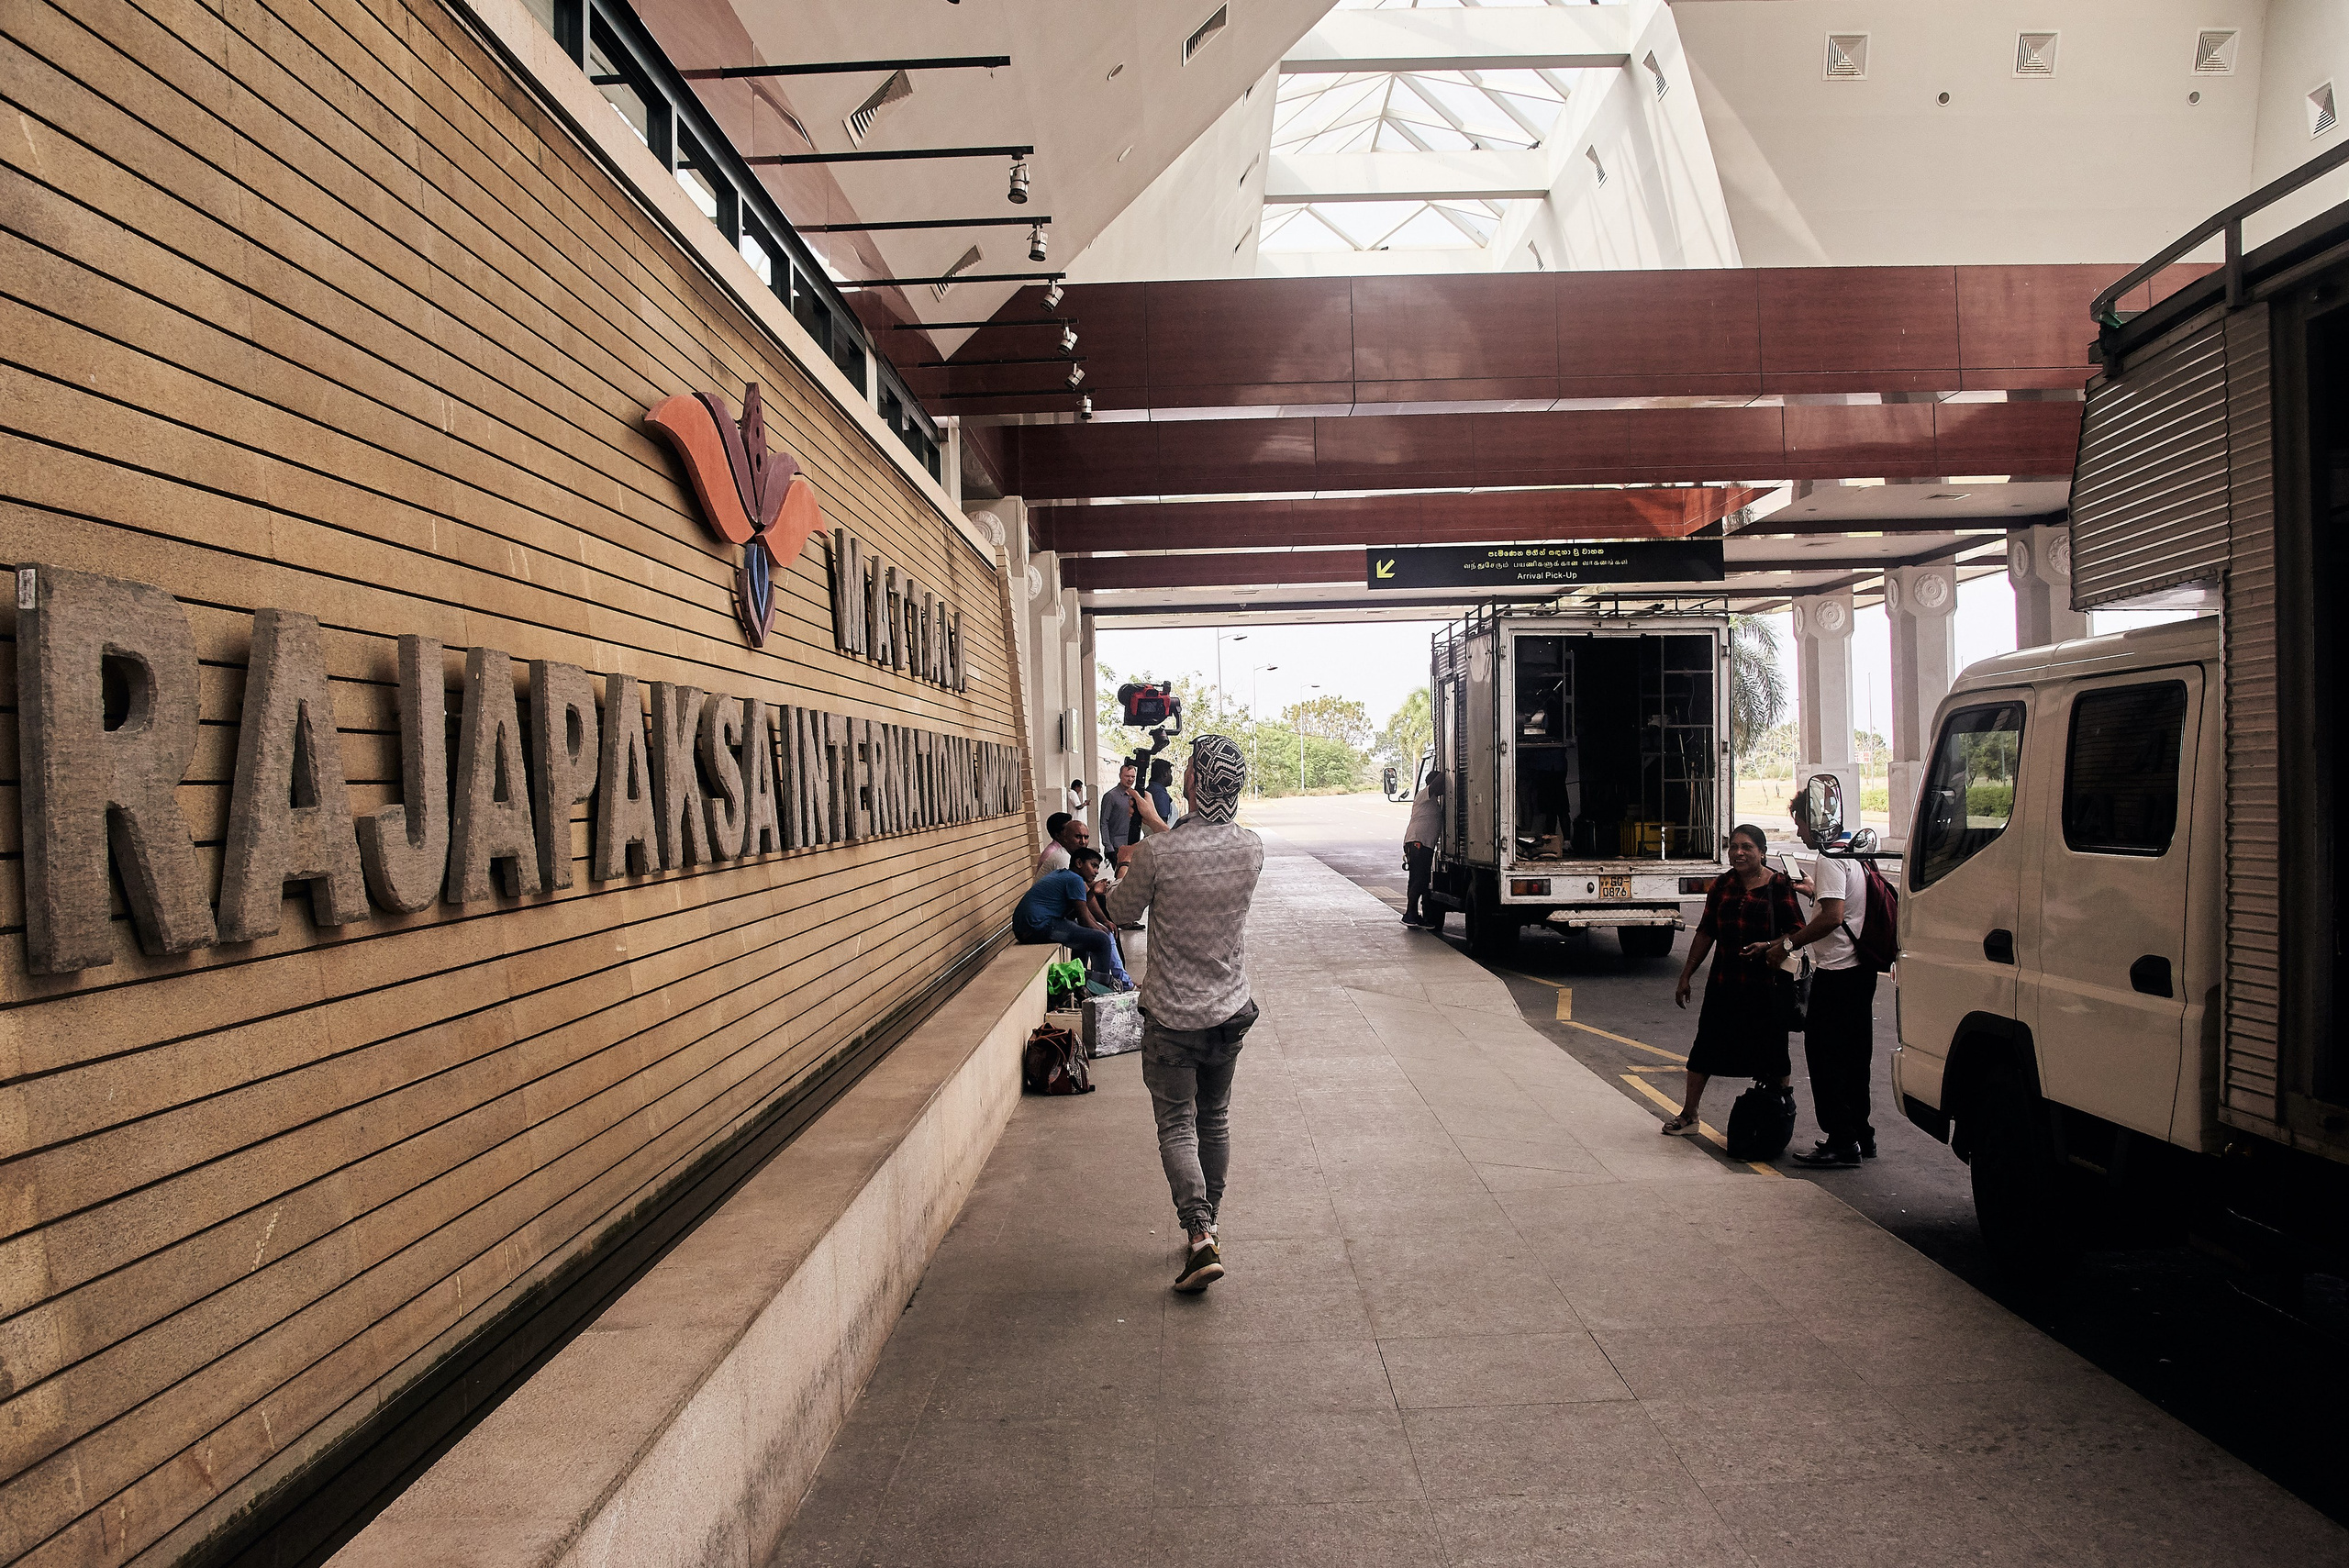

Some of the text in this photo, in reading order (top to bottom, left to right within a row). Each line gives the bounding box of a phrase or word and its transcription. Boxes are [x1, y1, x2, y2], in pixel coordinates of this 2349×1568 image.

[1517, 572, 1577, 580] Arrival Pick-Up
[15, 562, 780, 975] RAJAPAKSA
[780, 704, 978, 850] INTERNATIONAL
[1603, 887, 1627, 896] 0876
